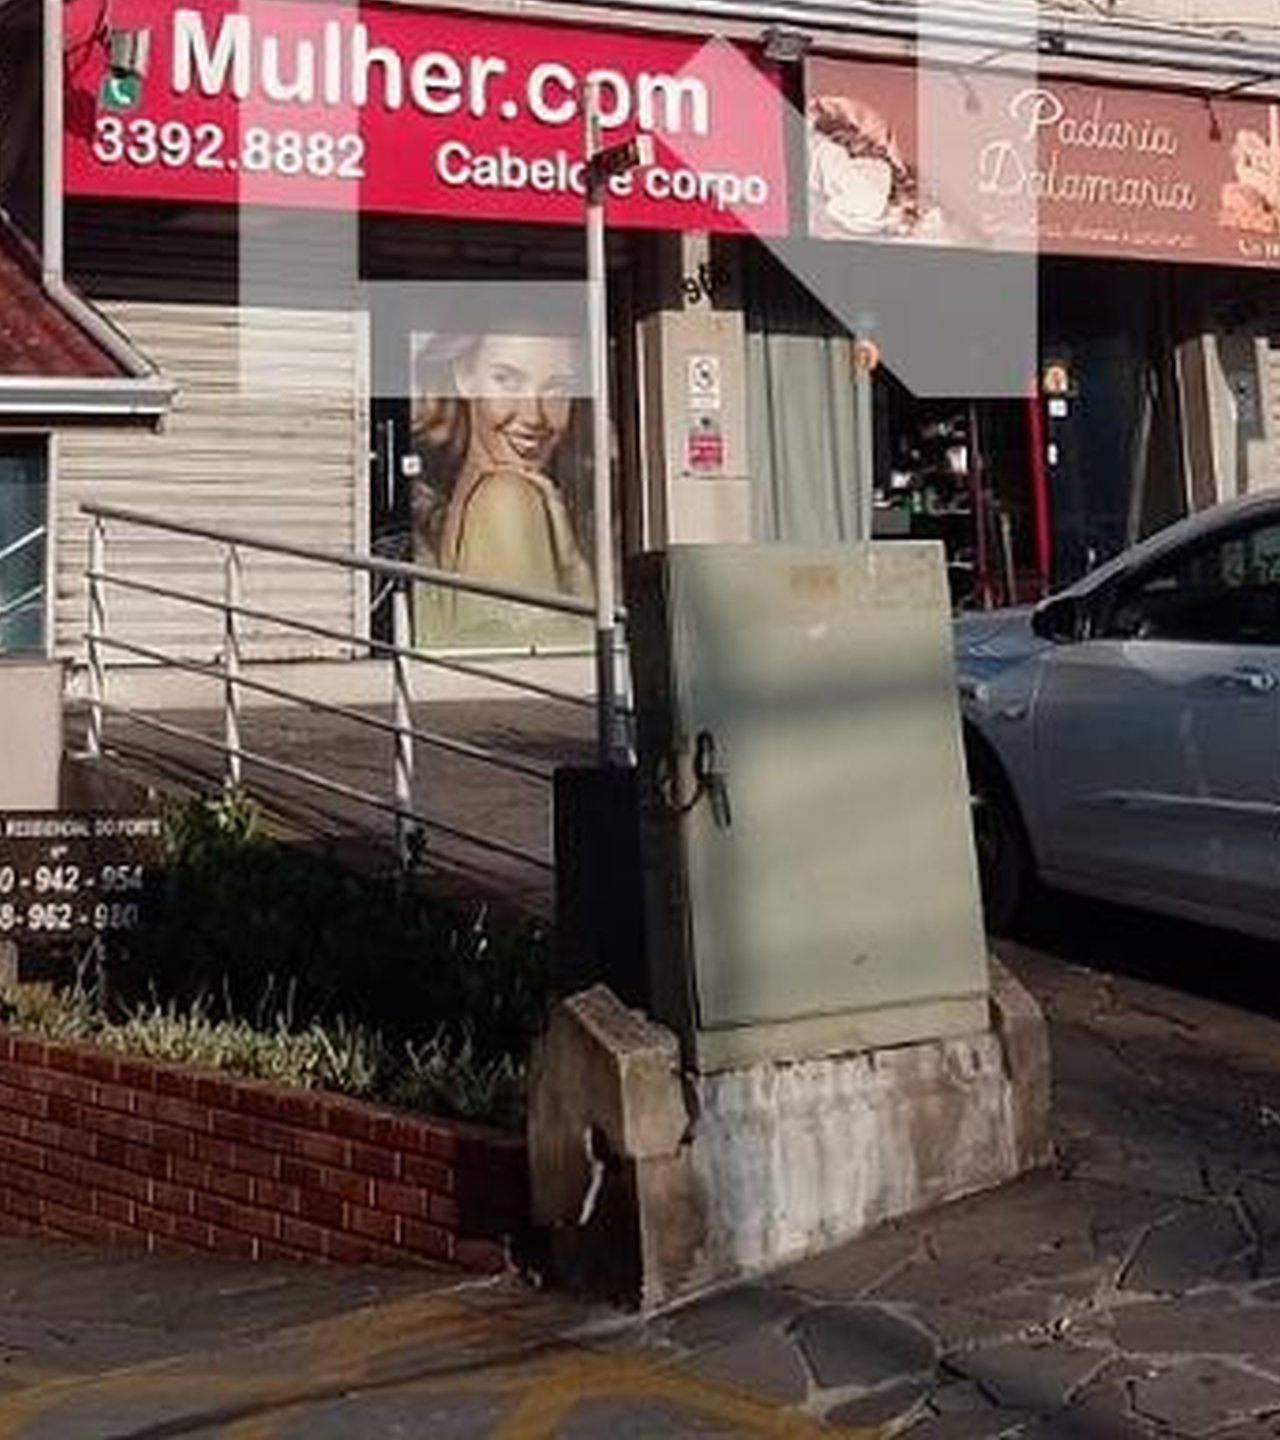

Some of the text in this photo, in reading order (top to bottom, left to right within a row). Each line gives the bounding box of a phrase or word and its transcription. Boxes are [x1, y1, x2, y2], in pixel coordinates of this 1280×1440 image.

[171, 8, 710, 136] Mulher.com
[92, 115, 366, 180] 3392.8882
[1009, 88, 1178, 157] Padaria
[645, 167, 769, 211] corpo
[34, 864, 81, 894] 942
